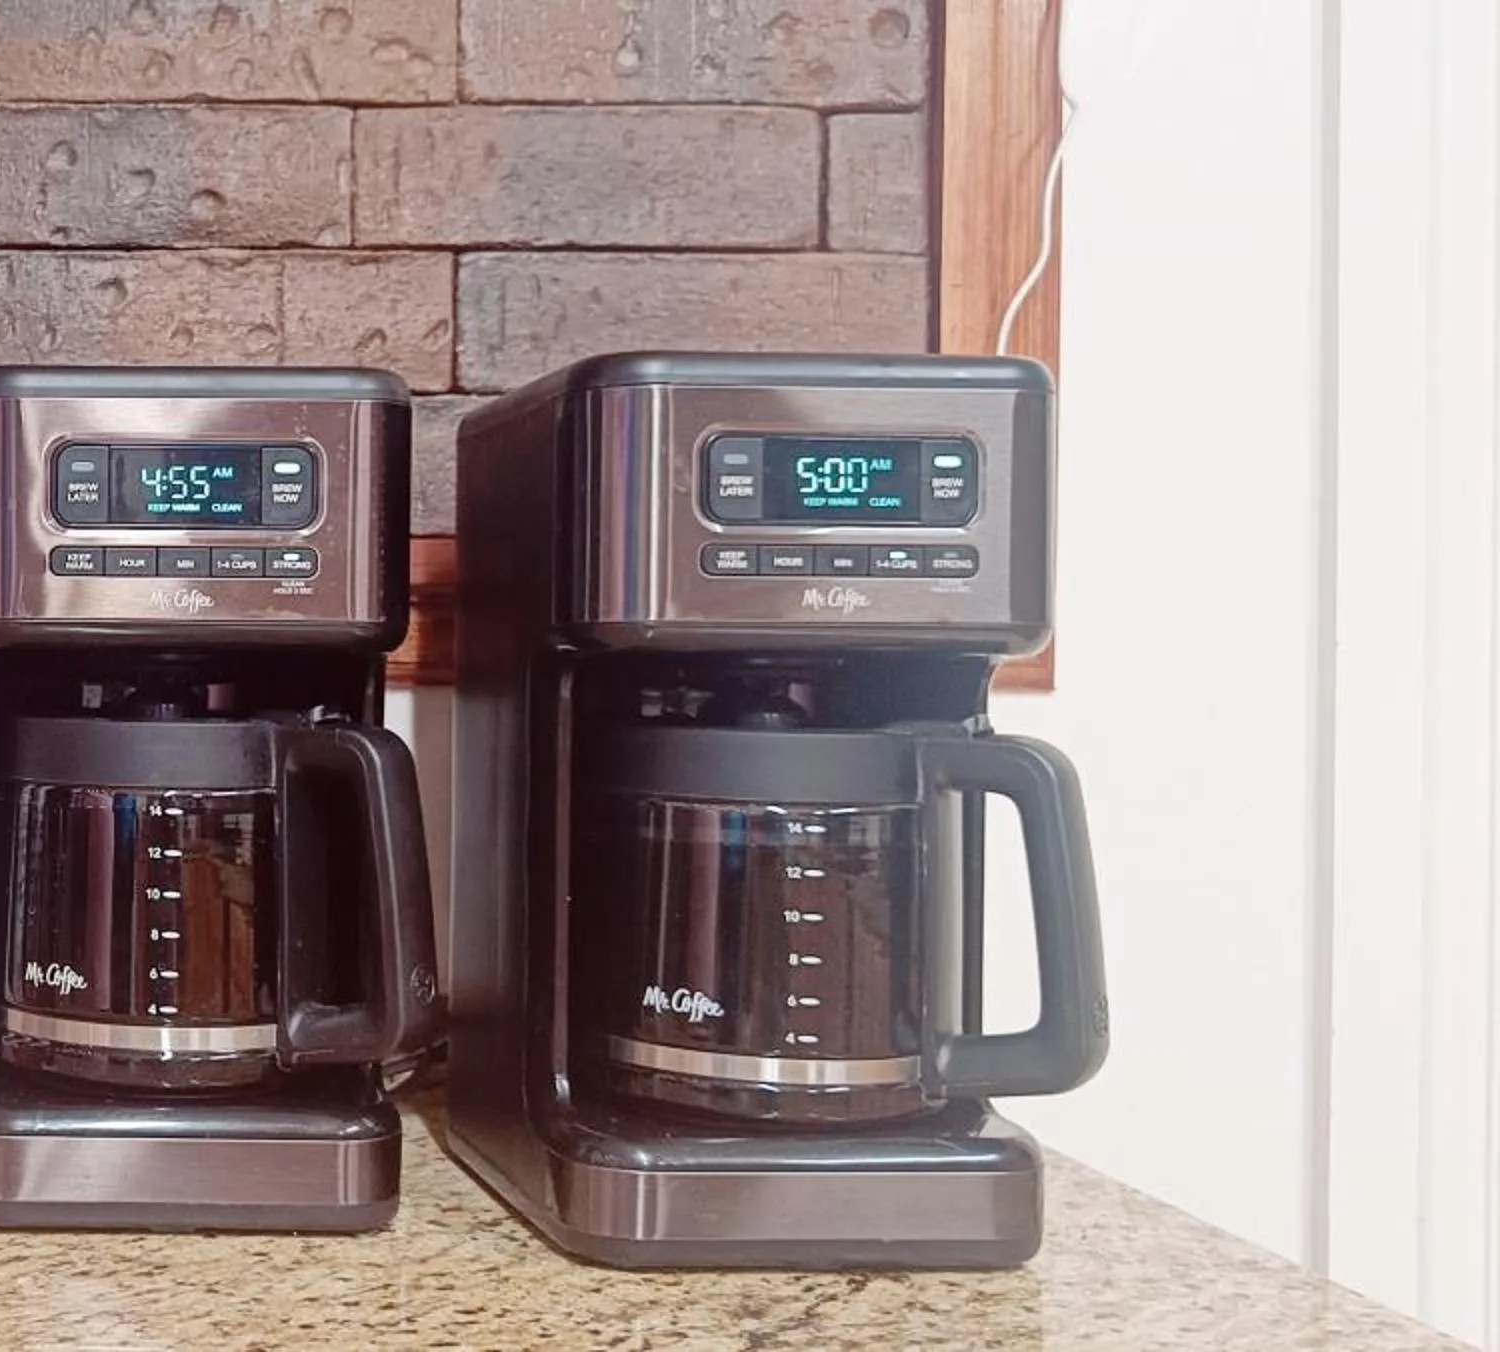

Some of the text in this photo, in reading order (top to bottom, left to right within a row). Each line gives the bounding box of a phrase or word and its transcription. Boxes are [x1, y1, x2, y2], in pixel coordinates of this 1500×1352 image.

[797, 458, 892, 493] 5:00 AM
[141, 466, 233, 499] 4:55 AM
[932, 478, 963, 488] BREW
[68, 483, 99, 493] BREW
[272, 484, 302, 493] BREW
[719, 487, 752, 497] LATER
[67, 493, 99, 502] LATER
[273, 493, 299, 503] NOW
[868, 497, 901, 507] CLEAN
[148, 503, 242, 513] KEEP WARM CLEAN
[119, 559, 146, 567] HOUR
[177, 559, 195, 568] MIN
[231, 560, 257, 570] CUPS
[272, 560, 312, 570] STRONG
[174, 588, 215, 613] Coffee
[827, 586, 871, 615] Coffee
[149, 806, 162, 816] 14
[148, 848, 161, 859] 12
[786, 867, 801, 878] 12
[146, 889, 160, 900] 10
[784, 911, 800, 922] 10
[151, 930, 159, 941] 8
[788, 954, 798, 966] 8
[46, 962, 87, 995] Coffee
[150, 969, 158, 980] 6
[671, 988, 724, 1021] Coffee
[787, 996, 796, 1007] 6
[148, 1005, 157, 1015] 4
[786, 1034, 795, 1044] 4
